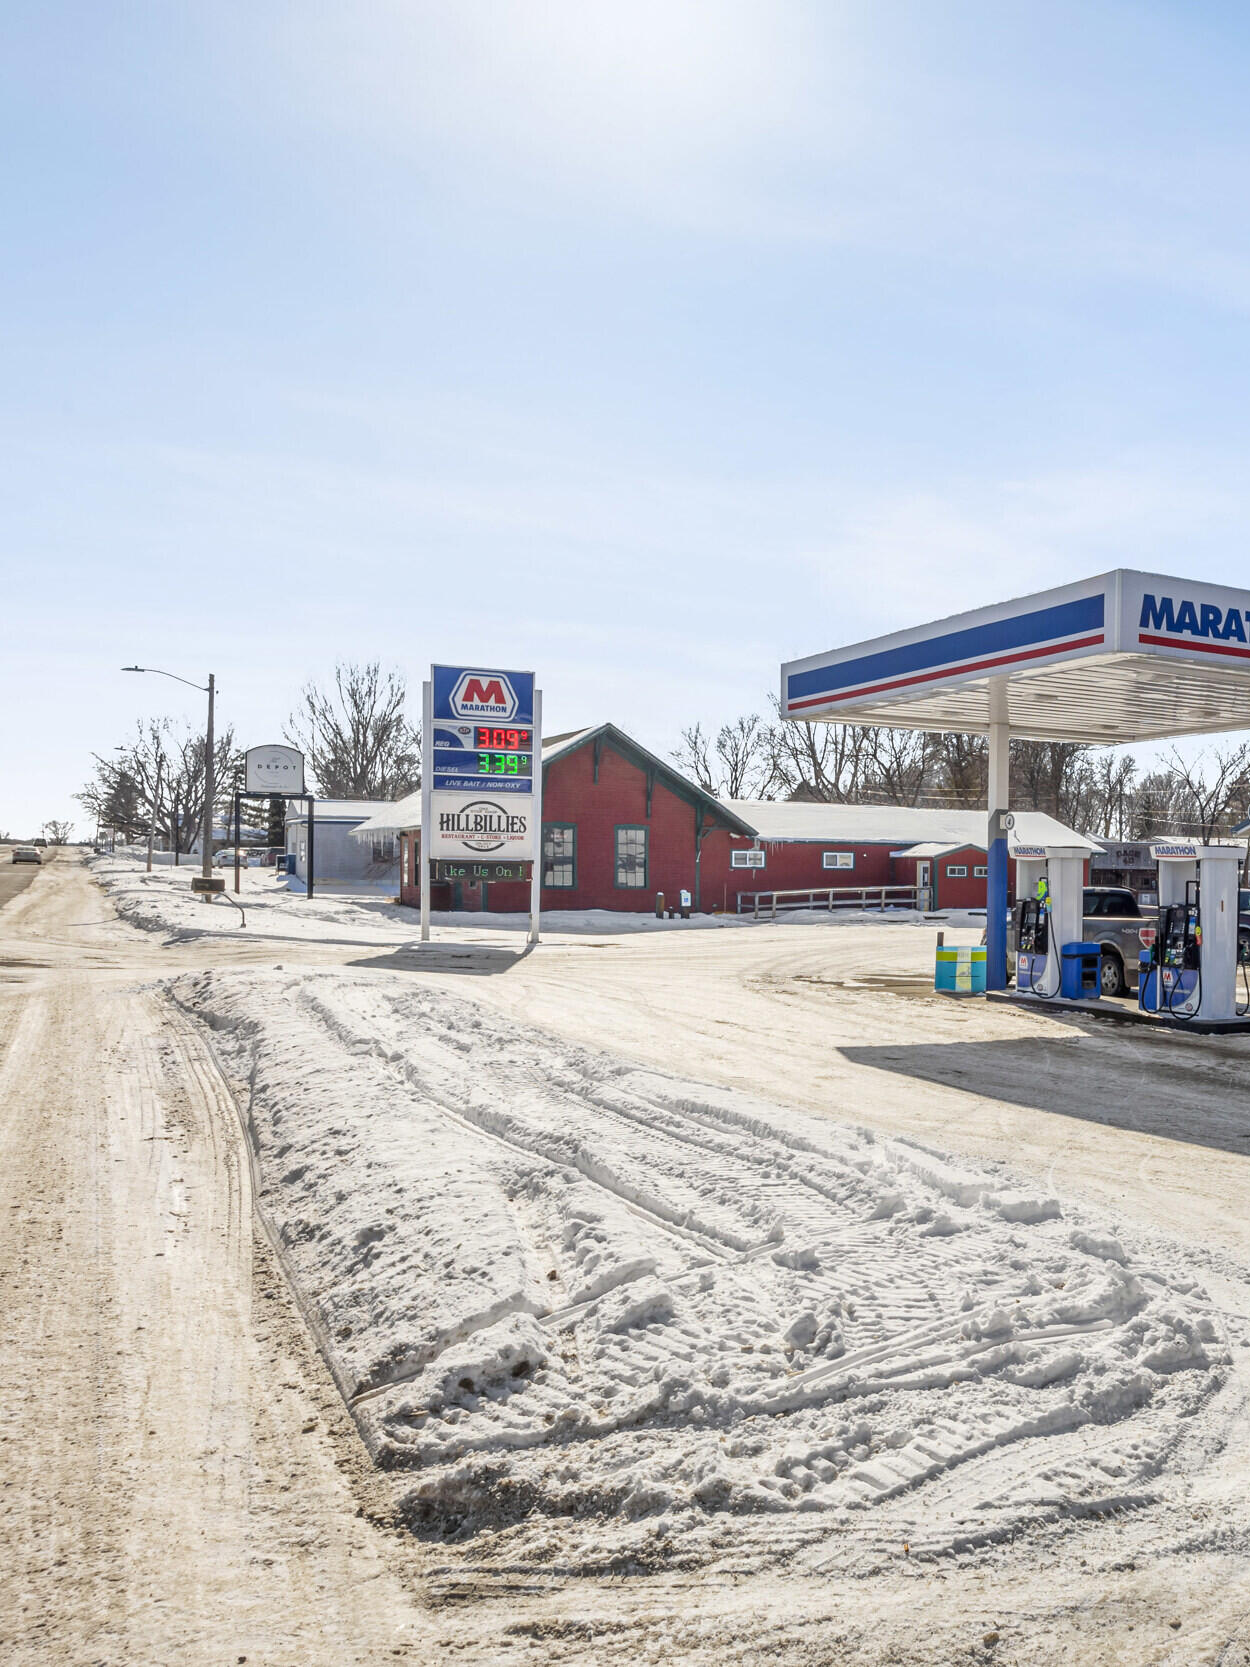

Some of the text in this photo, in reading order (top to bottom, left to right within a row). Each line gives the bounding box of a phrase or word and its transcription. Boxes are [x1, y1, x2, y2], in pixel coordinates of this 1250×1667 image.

[462, 679, 506, 704] M
[461, 704, 507, 712] MARATHON
[439, 813, 527, 833] HILLBILLIES
[1015, 847, 1045, 855] MARATHON
[1155, 846, 1196, 855] MARATHON
[473, 866, 488, 876] Us
[496, 866, 512, 877] On
